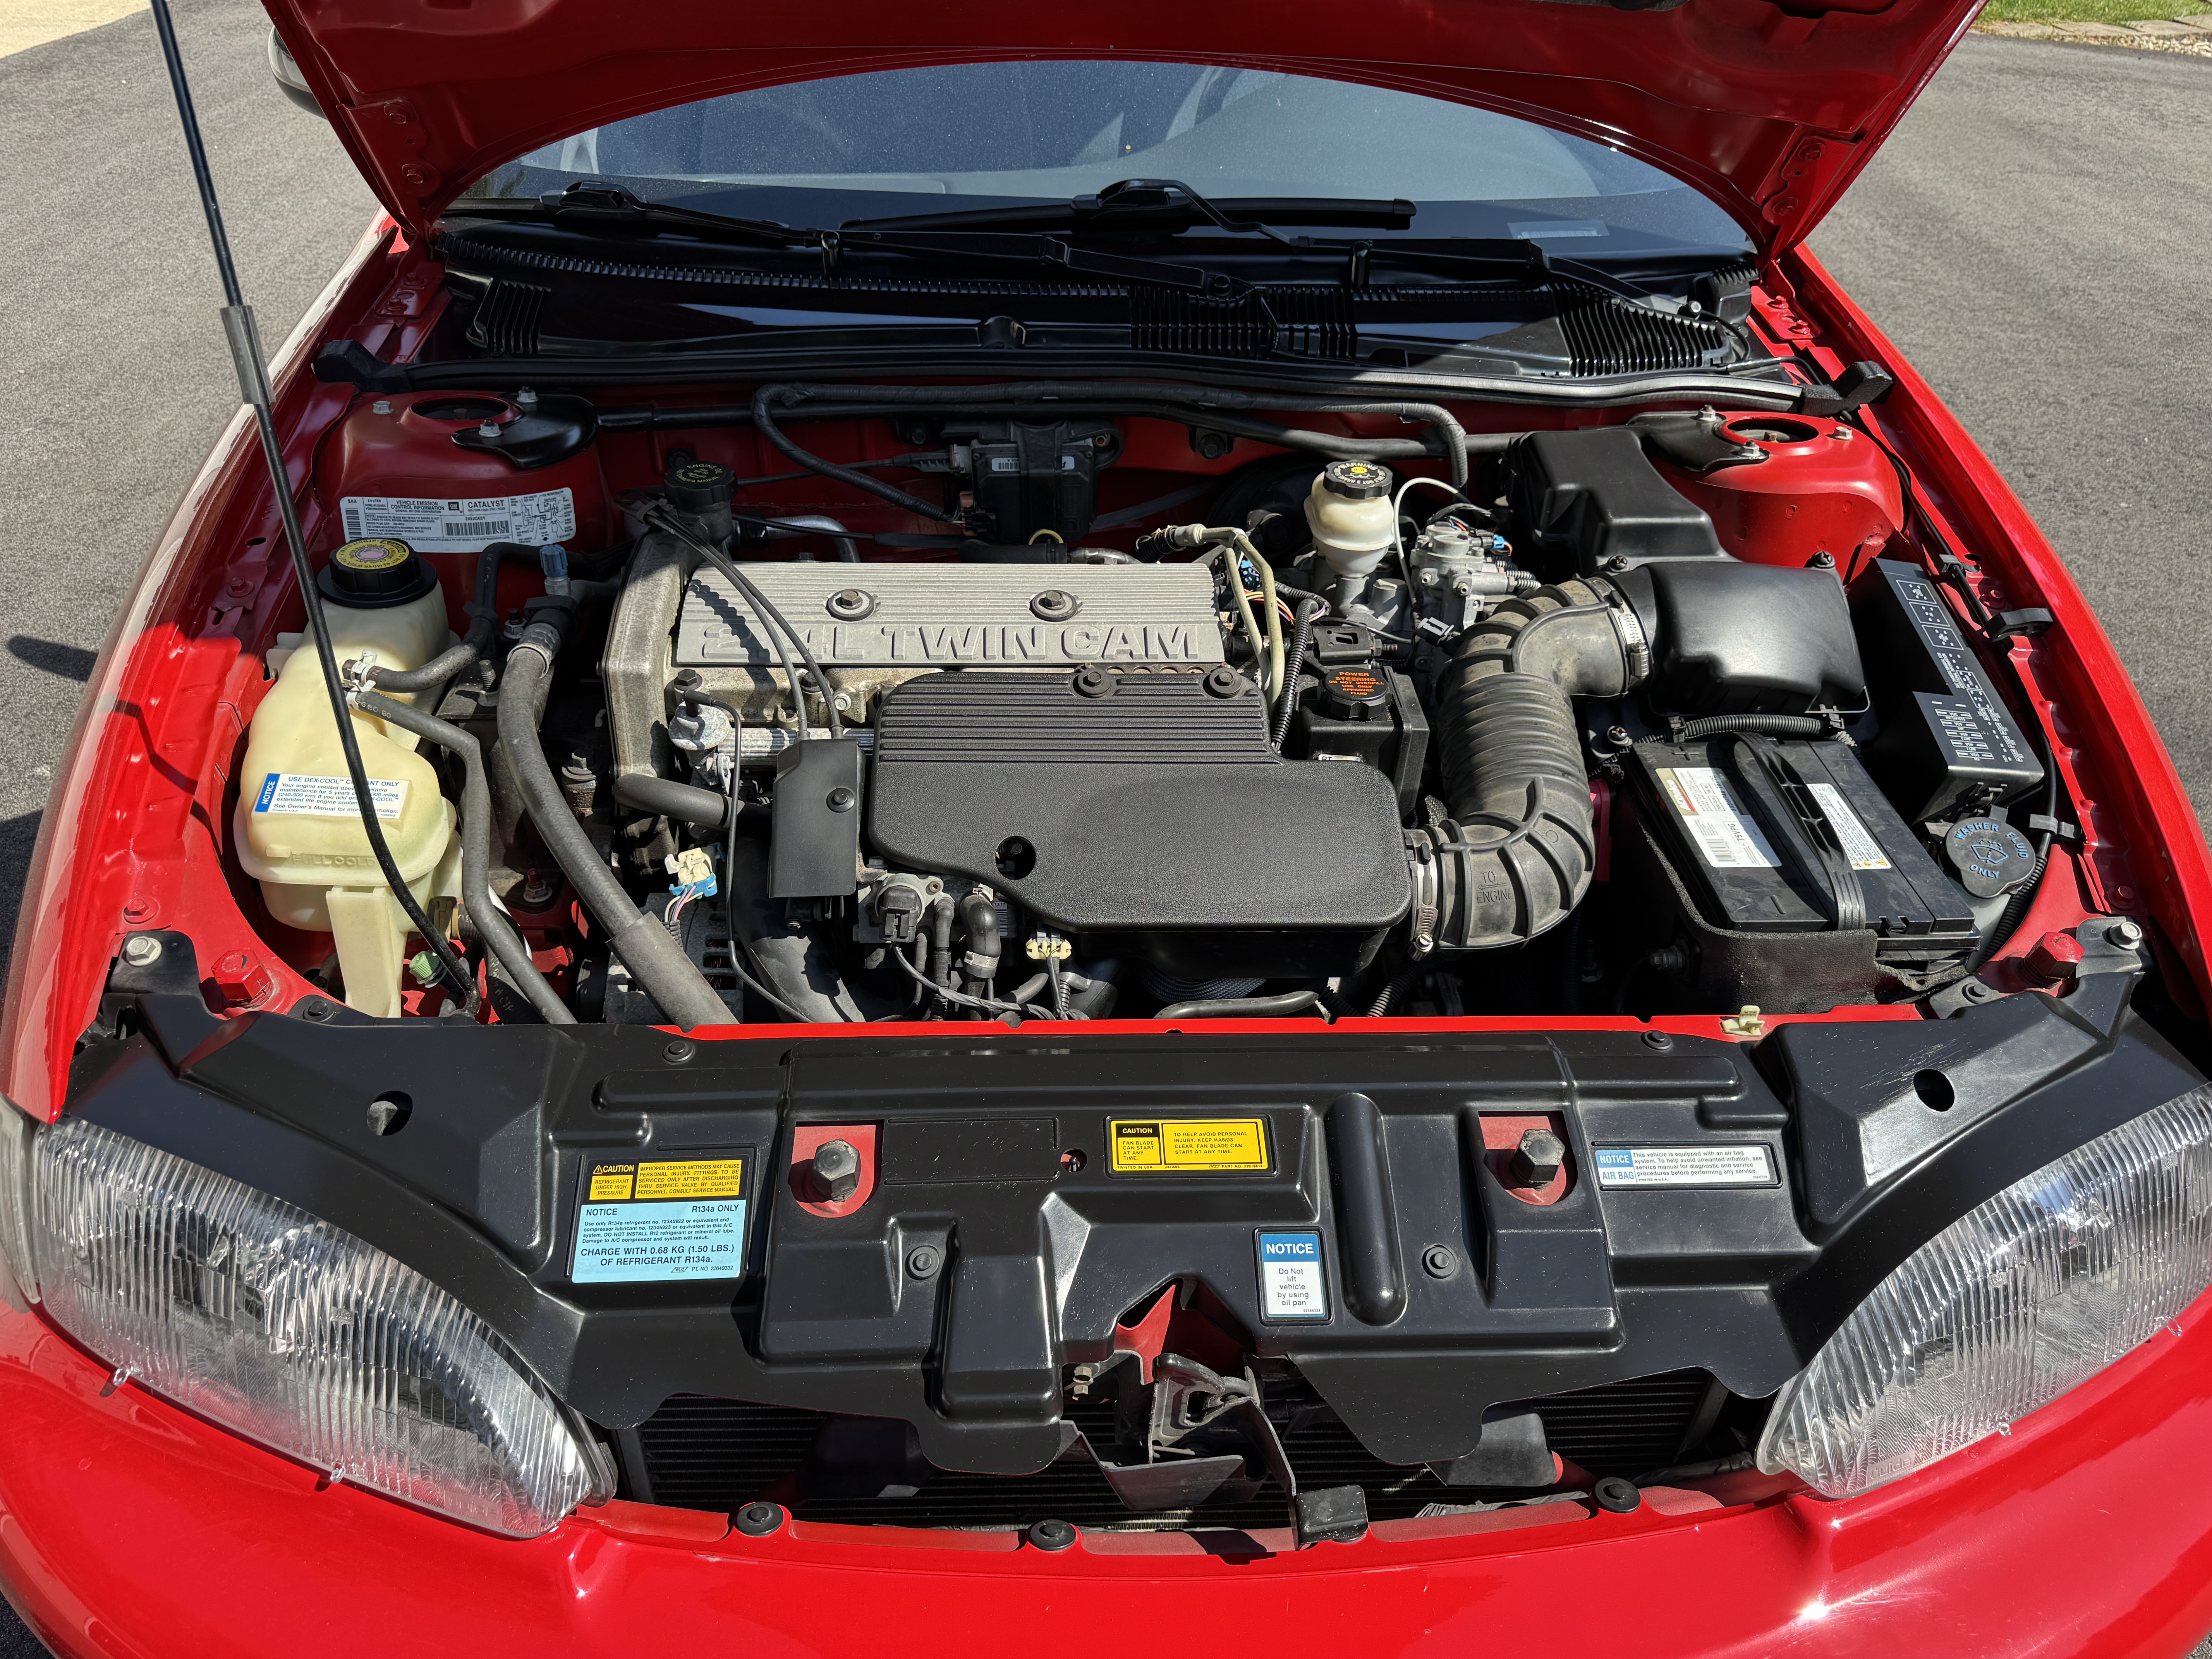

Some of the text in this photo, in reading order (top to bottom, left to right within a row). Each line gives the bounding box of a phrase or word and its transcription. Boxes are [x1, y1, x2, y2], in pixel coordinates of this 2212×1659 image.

[1338, 462, 1378, 471] WARNING
[468, 500, 505, 508] CATALYST
[881, 624, 1046, 659] TWIN
[1061, 624, 1200, 659] CAM
[261, 781, 276, 804] NOTICE
[1728, 823, 1745, 842] 75VPG
[1954, 822, 1999, 840] WASHER
[2006, 832, 2028, 859] FLUID
[291, 855, 376, 867] FULL COLD
[1970, 864, 2000, 878] ONLY
[1480, 871, 1496, 884] TO
[1476, 888, 1514, 904] ENGINE
[1600, 1155, 1630, 1163] NOTICE
[602, 1165, 634, 1173] CAUTION
[1618, 1171, 1635, 1179] BAG
[689, 1246, 708, 1254] (1.50
[711, 1245, 734, 1253] LBS.)
[1266, 1243, 1314, 1254] NOTICE
[617, 1257, 682, 1265] REFRIGERANT
